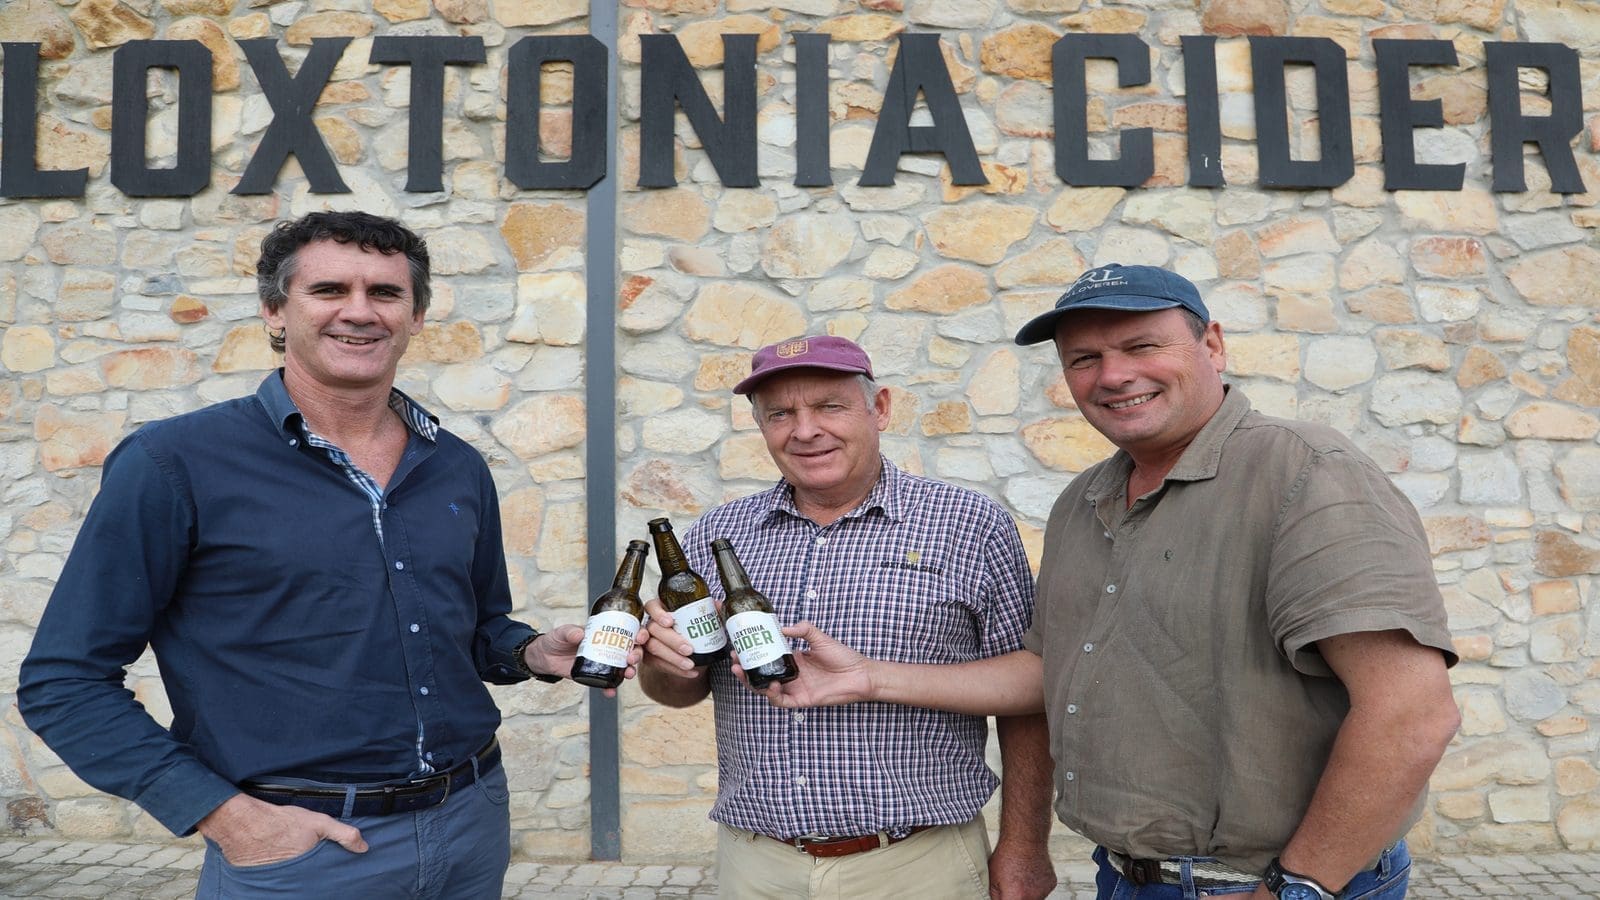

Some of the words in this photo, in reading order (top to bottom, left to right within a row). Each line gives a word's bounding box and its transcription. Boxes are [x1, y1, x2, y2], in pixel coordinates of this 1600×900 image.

[0, 33, 989, 198] LOXTONIA
[1052, 33, 1587, 194] CIDER
[601, 625, 634, 639] LOXTONIA
[686, 614, 721, 639] CIDE
[591, 630, 634, 653] CIDER
[733, 630, 775, 655] CIDER
